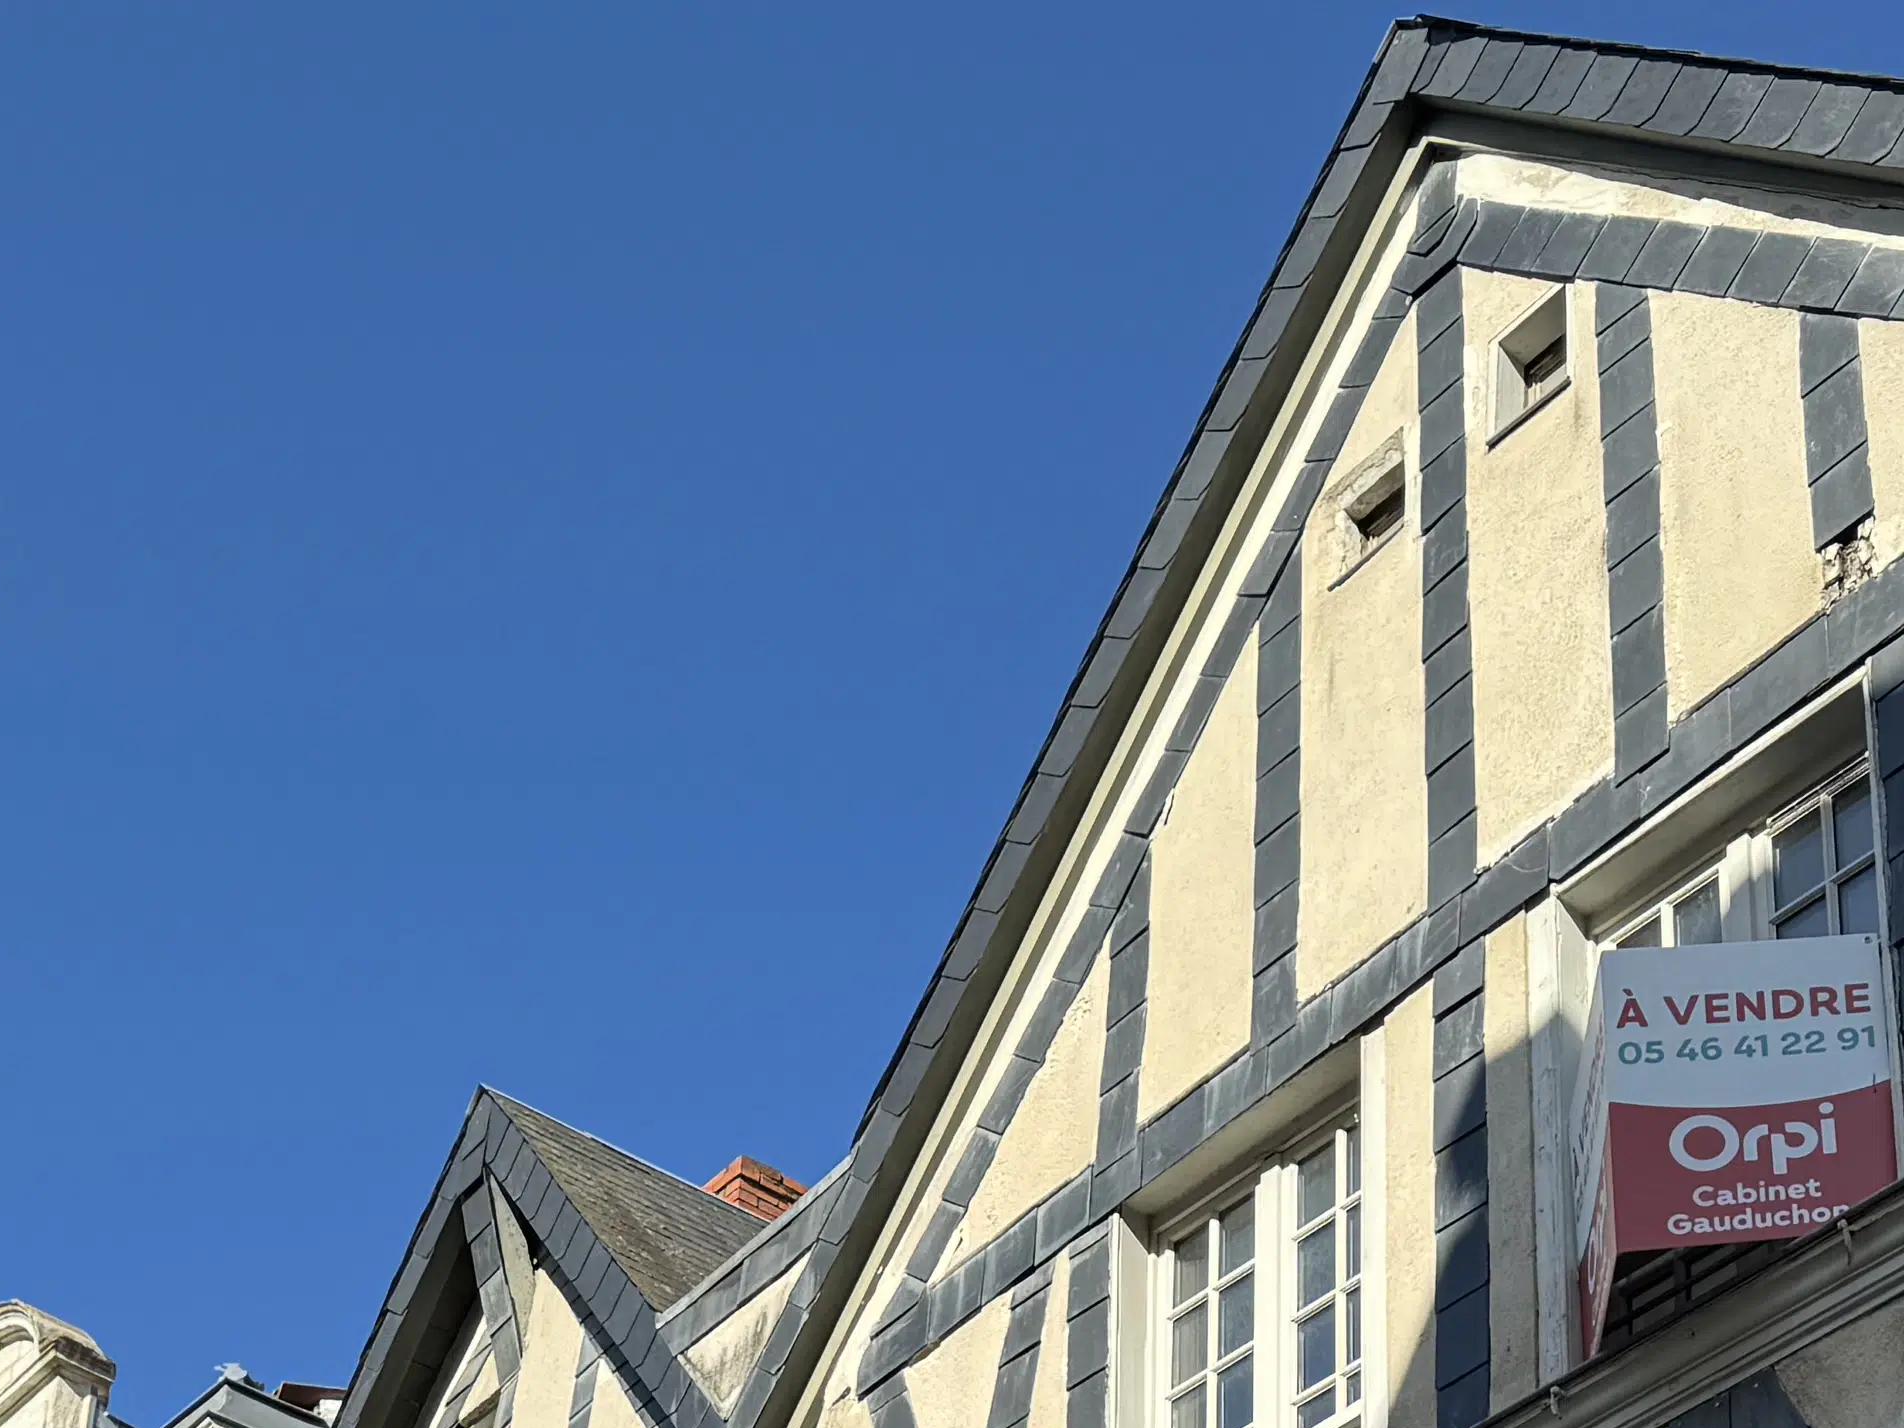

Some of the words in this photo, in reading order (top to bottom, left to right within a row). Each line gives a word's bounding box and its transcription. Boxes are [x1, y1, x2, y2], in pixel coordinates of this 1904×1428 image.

[1616, 988, 1648, 1029] À
[1663, 983, 1872, 1025] VENDRE
[1618, 1040, 1665, 1065] 05
[1676, 1037, 1722, 1062] 46
[1734, 1034, 1769, 1058] 41
[1781, 1030, 1827, 1055] 22
[1836, 1025, 1876, 1051] 91
[1669, 1102, 1838, 1175] Orpi
[1692, 1178, 1822, 1207] Cabinet
